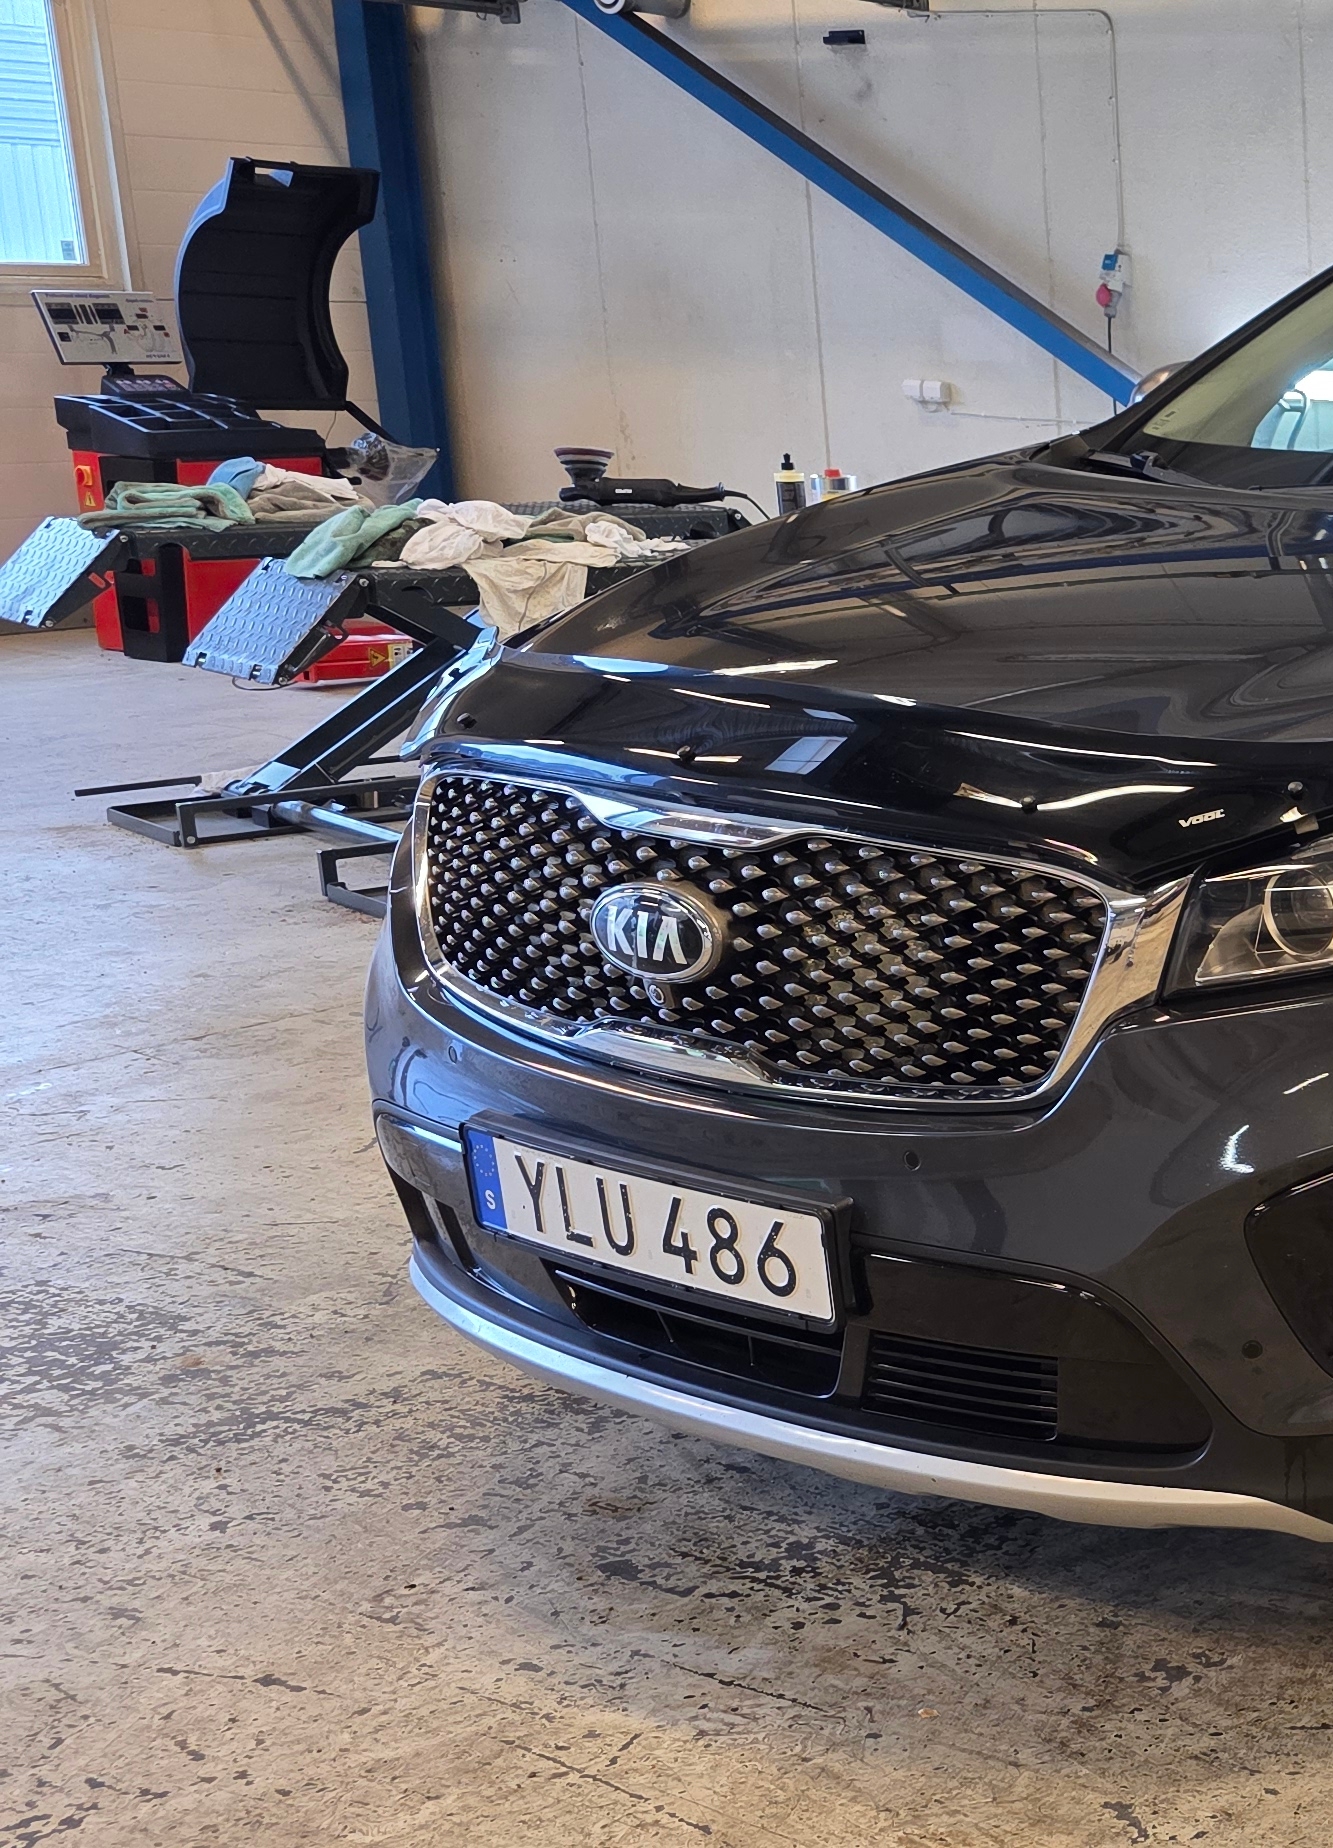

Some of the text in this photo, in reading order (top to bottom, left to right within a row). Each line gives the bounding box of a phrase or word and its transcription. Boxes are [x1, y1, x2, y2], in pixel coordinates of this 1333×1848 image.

[606, 905, 688, 965] KIA
[485, 1189, 497, 1211] S
[514, 1154, 797, 1298] YLU 486
